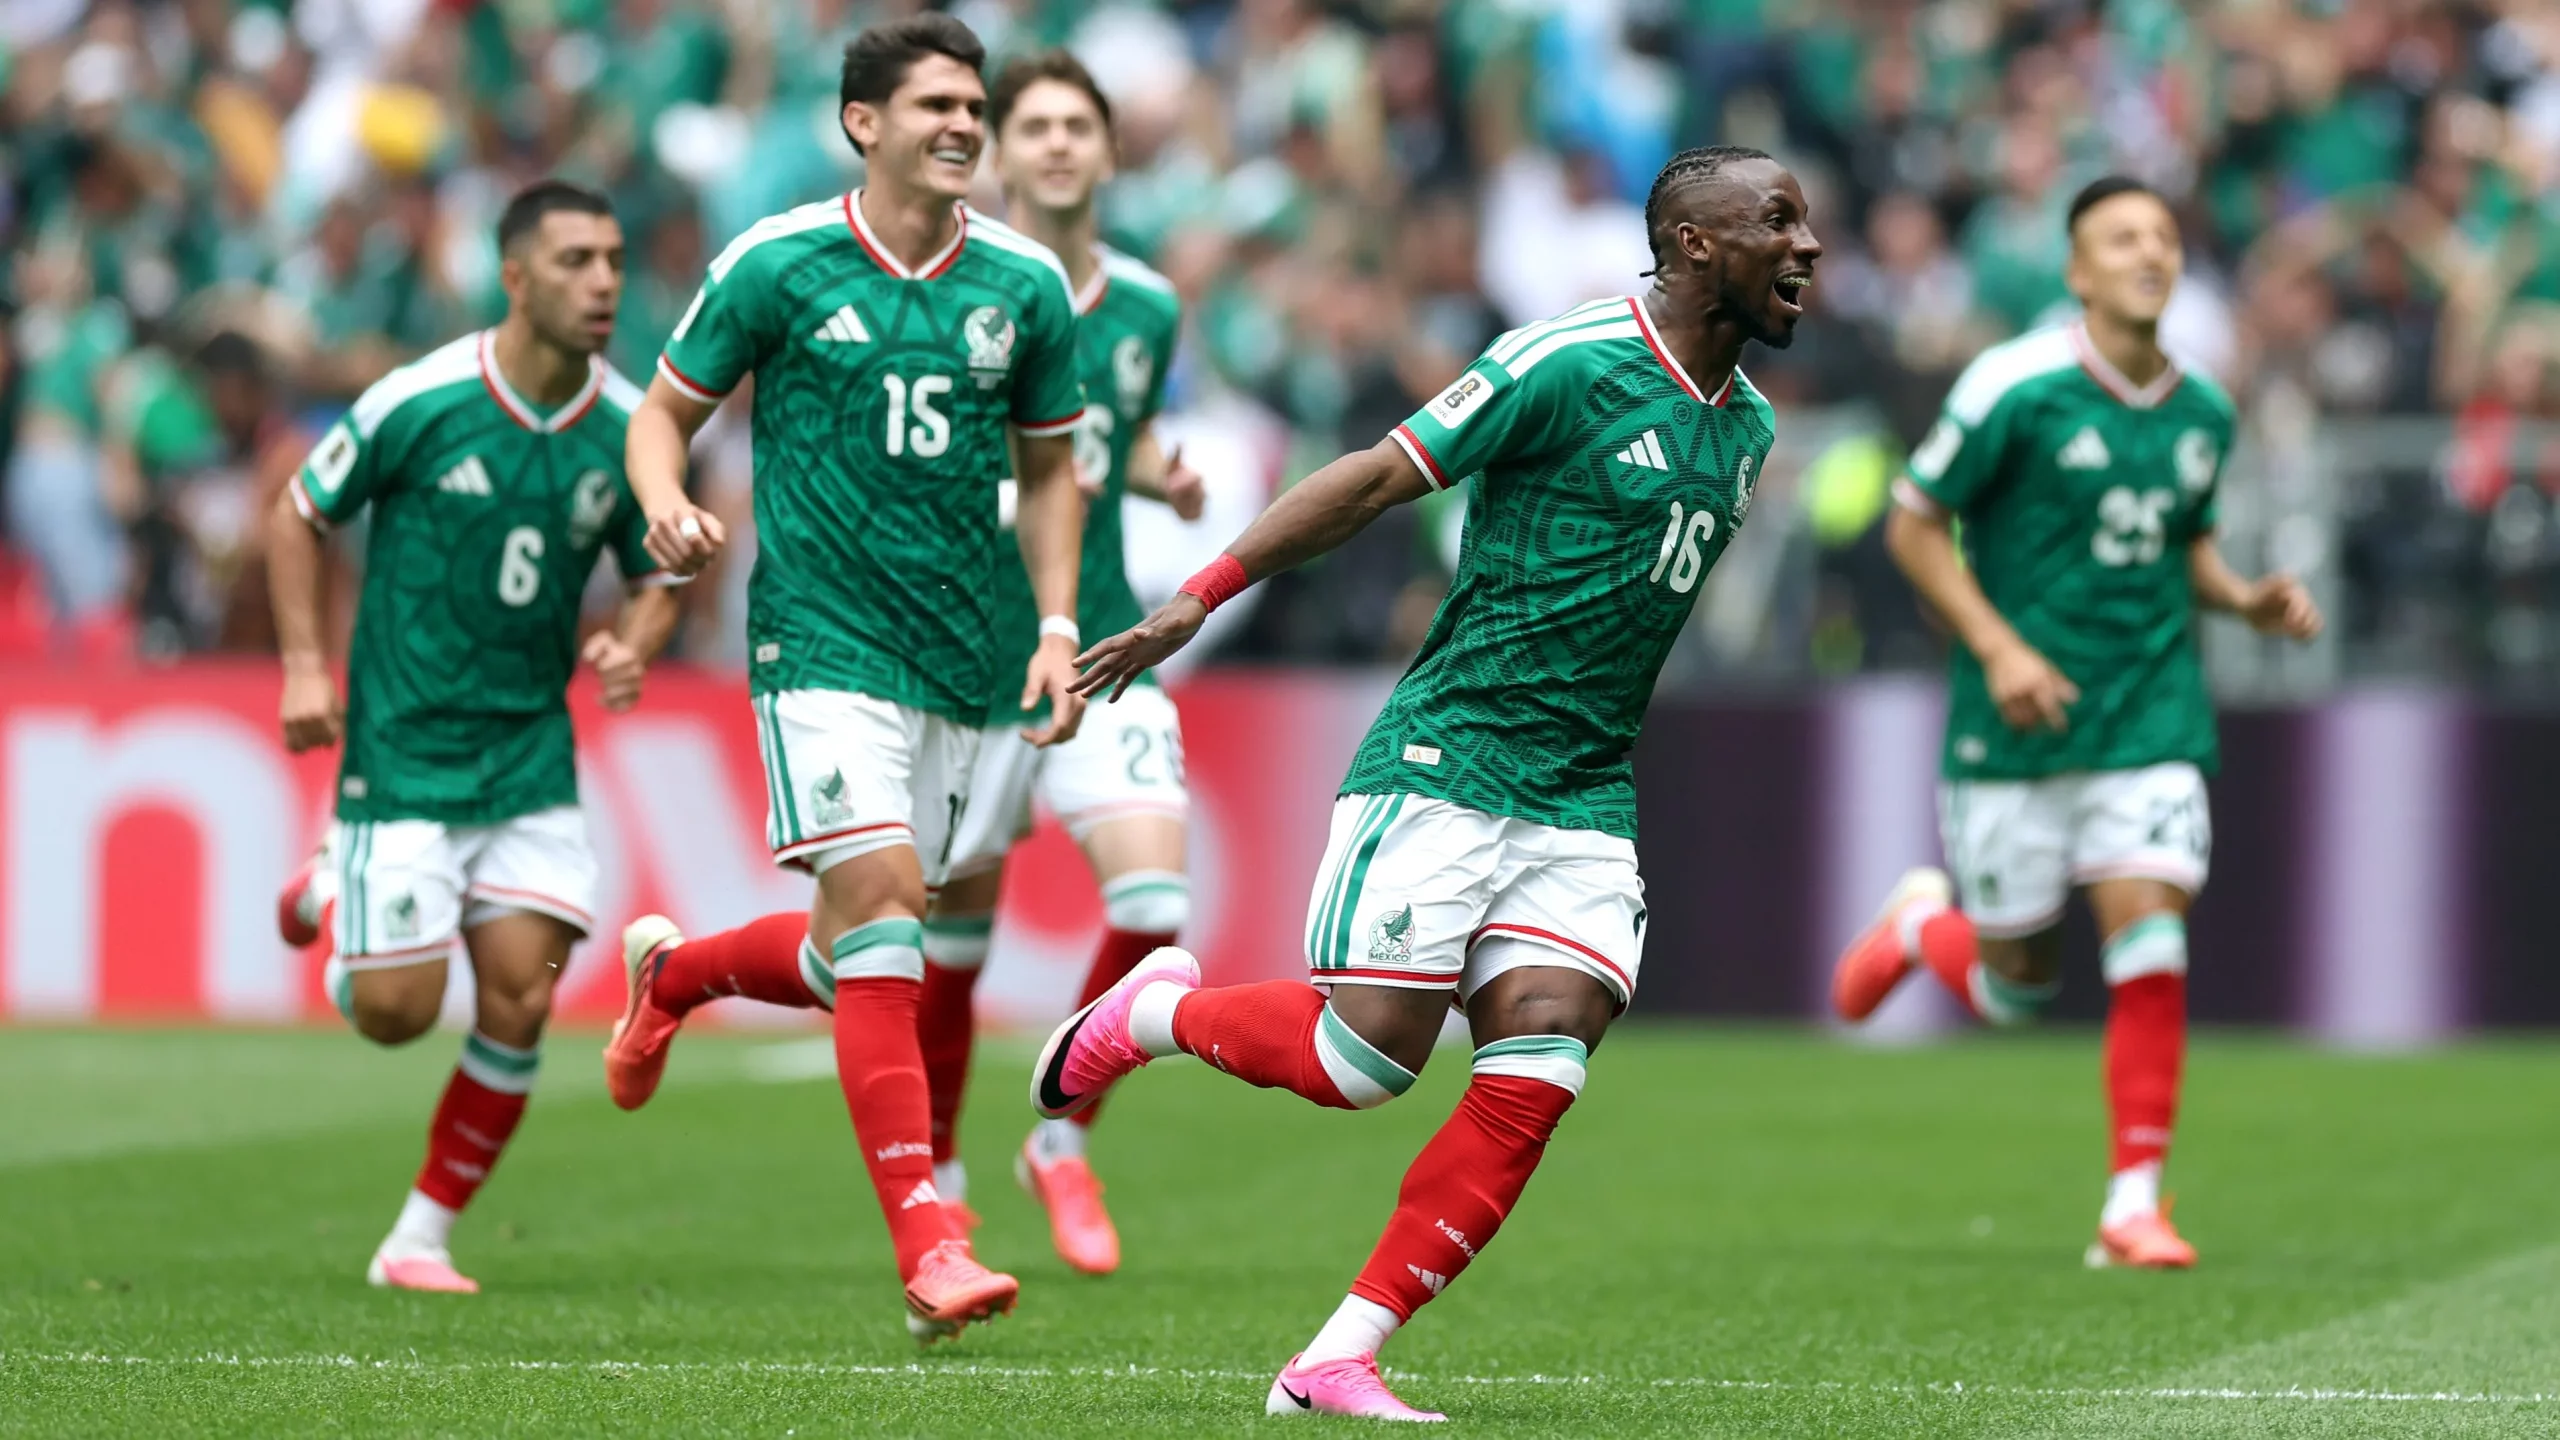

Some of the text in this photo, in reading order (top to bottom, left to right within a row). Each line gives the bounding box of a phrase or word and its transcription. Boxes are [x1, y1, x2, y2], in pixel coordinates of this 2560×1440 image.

[883, 373, 953, 457] 15
[499, 525, 545, 607] 6
[1650, 501, 1715, 593] 16
[2091, 486, 2176, 567] 25
[1370, 951, 1409, 963] MÉXICO
